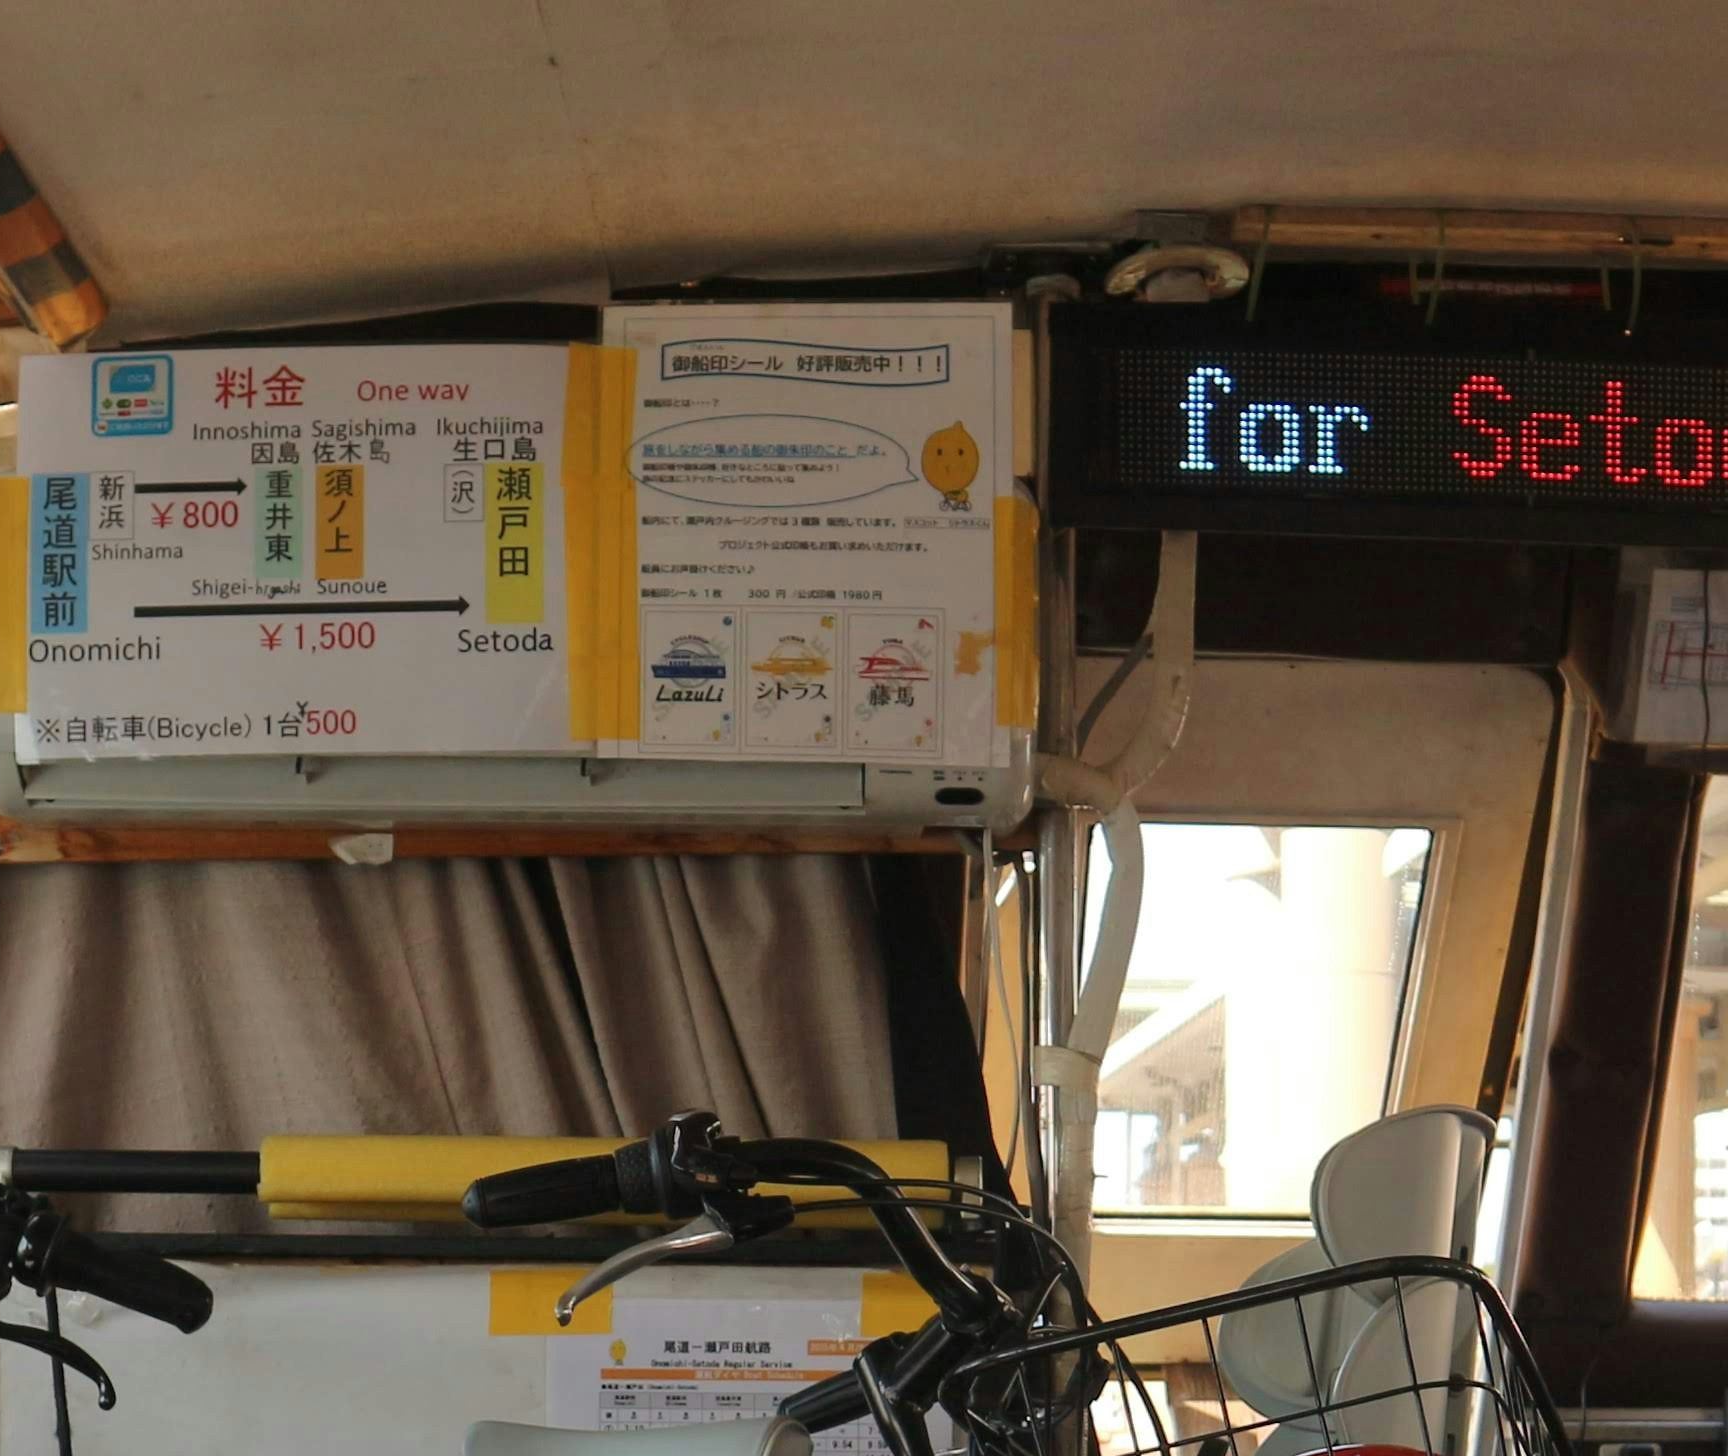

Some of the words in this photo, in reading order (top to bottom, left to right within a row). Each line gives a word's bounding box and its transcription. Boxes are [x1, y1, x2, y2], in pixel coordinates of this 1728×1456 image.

[672, 355, 784, 372] 御船印シール
[214, 364, 305, 409] 料金
[357, 380, 409, 402] One
[418, 382, 470, 402] way
[193, 422, 302, 441] Innoshima
[312, 418, 417, 442] Sagishima
[436, 417, 544, 438] Ikuchijima
[1176, 364, 1373, 477] for
[251, 442, 301, 465] 因島
[312, 438, 391, 465] 佐木島
[452, 437, 537, 462] 生口島
[99, 474, 125, 530] 新浜
[325, 469, 354, 553] 須ノ上
[265, 470, 294, 563] 重井東
[496, 467, 533, 578] 瀬戸田
[42, 476, 78, 628] 尾道駅前
[92, 543, 184, 561] Shinhama
[317, 579, 387, 595] Sunoue
[29, 636, 162, 663] Onomichi
[457, 627, 555, 653] Setoda
[757, 682, 828, 701] シトラス
